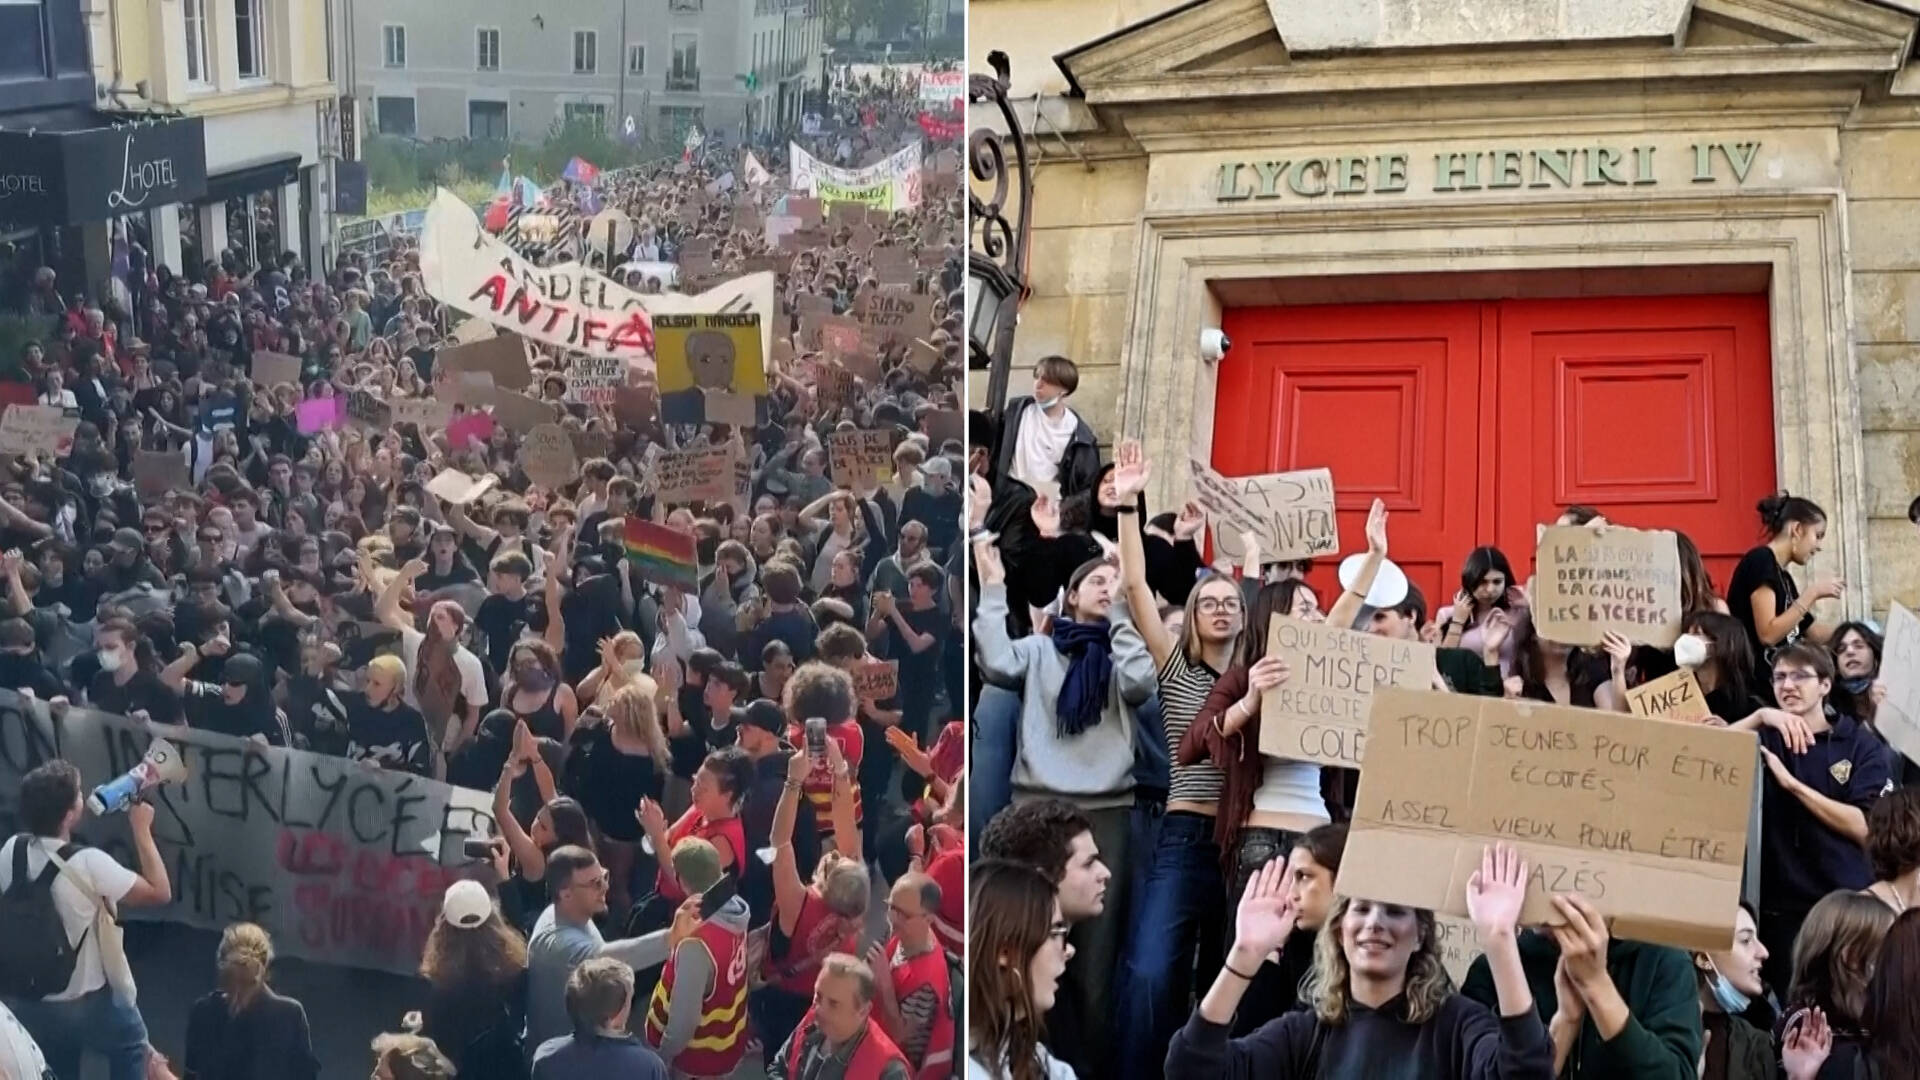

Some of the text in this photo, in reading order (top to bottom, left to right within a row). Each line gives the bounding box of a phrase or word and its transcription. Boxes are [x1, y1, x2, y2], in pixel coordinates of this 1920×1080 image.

[1217, 141, 1762, 201] LYCEE HENRI IV
[705, 313, 760, 328] MANDELA
[1554, 545, 1579, 563] LA
[1557, 582, 1656, 604] LA GAUCHE
[1548, 604, 1580, 622] LES
[1278, 624, 1318, 651] QUI
[1391, 645, 1412, 664] LA
[1634, 680, 1694, 717] TAXEZ
[1300, 724, 1367, 764] COLÈ
[1398, 716, 1471, 748] TROP
[1489, 724, 1577, 751] JEUNES
[1594, 735, 1650, 770] POUR
[1382, 800, 1455, 828] ASSEZ
[1493, 816, 1556, 839] VIEUX
[1579, 823, 1633, 852] POUR
[1526, 861, 1606, 899] AZÉS
